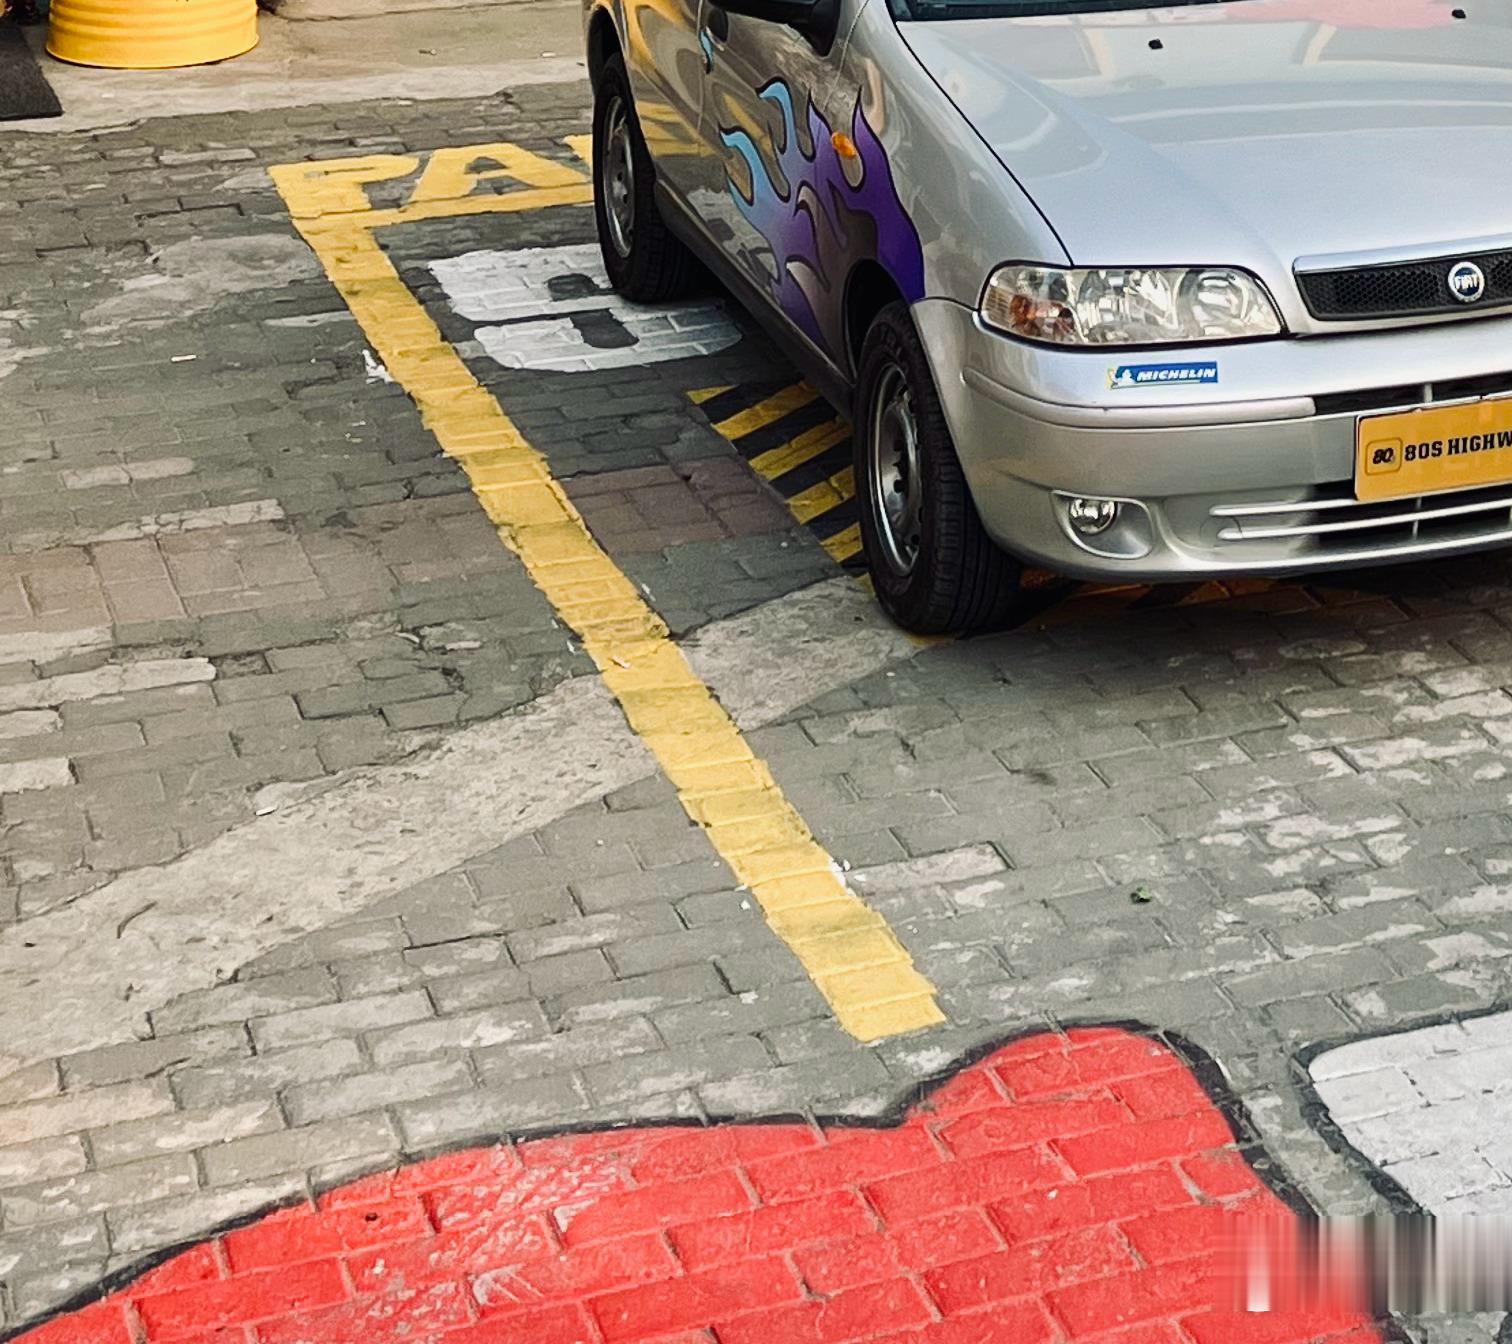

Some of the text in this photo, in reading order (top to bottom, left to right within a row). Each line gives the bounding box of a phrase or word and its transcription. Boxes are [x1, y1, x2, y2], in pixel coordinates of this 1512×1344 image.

[1453, 273, 1480, 291] FIAT
[1135, 367, 1217, 382] MICHELIN
[1404, 439, 1443, 462] 80S
